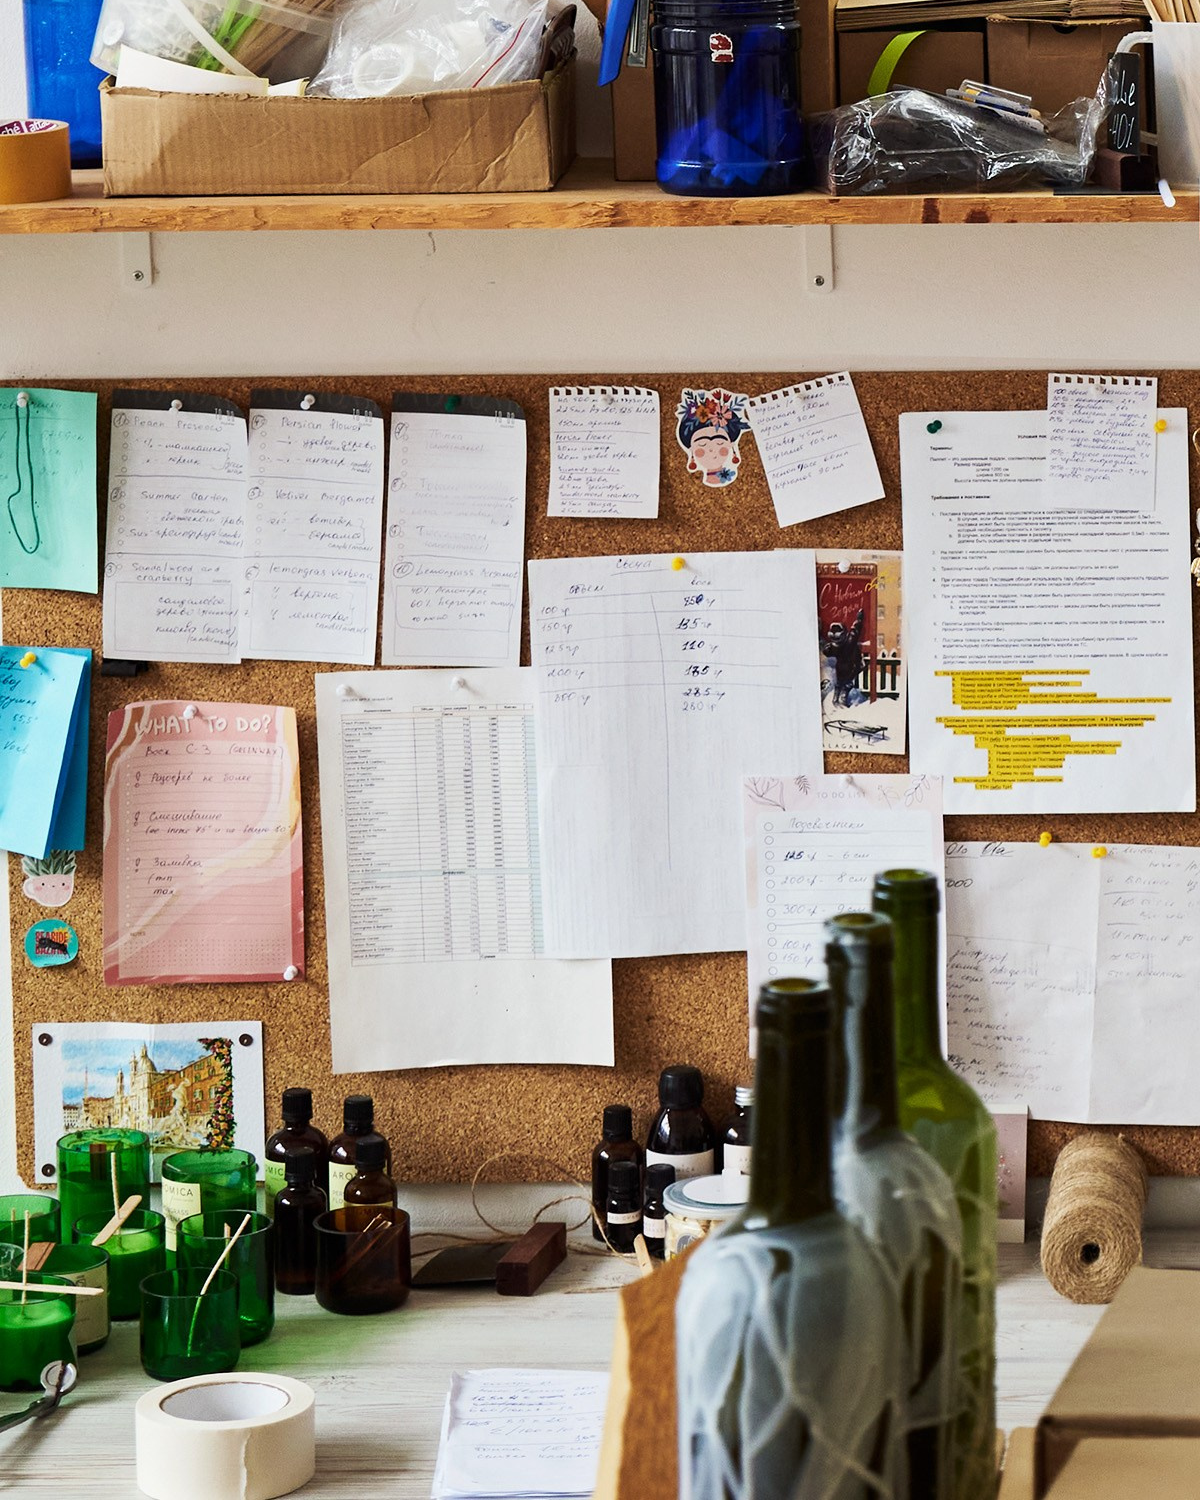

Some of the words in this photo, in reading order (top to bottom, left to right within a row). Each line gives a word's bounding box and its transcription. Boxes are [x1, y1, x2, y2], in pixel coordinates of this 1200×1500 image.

[135, 715, 192, 736] WHAT
[206, 715, 228, 733] TO
[236, 716, 272, 734] DO?
